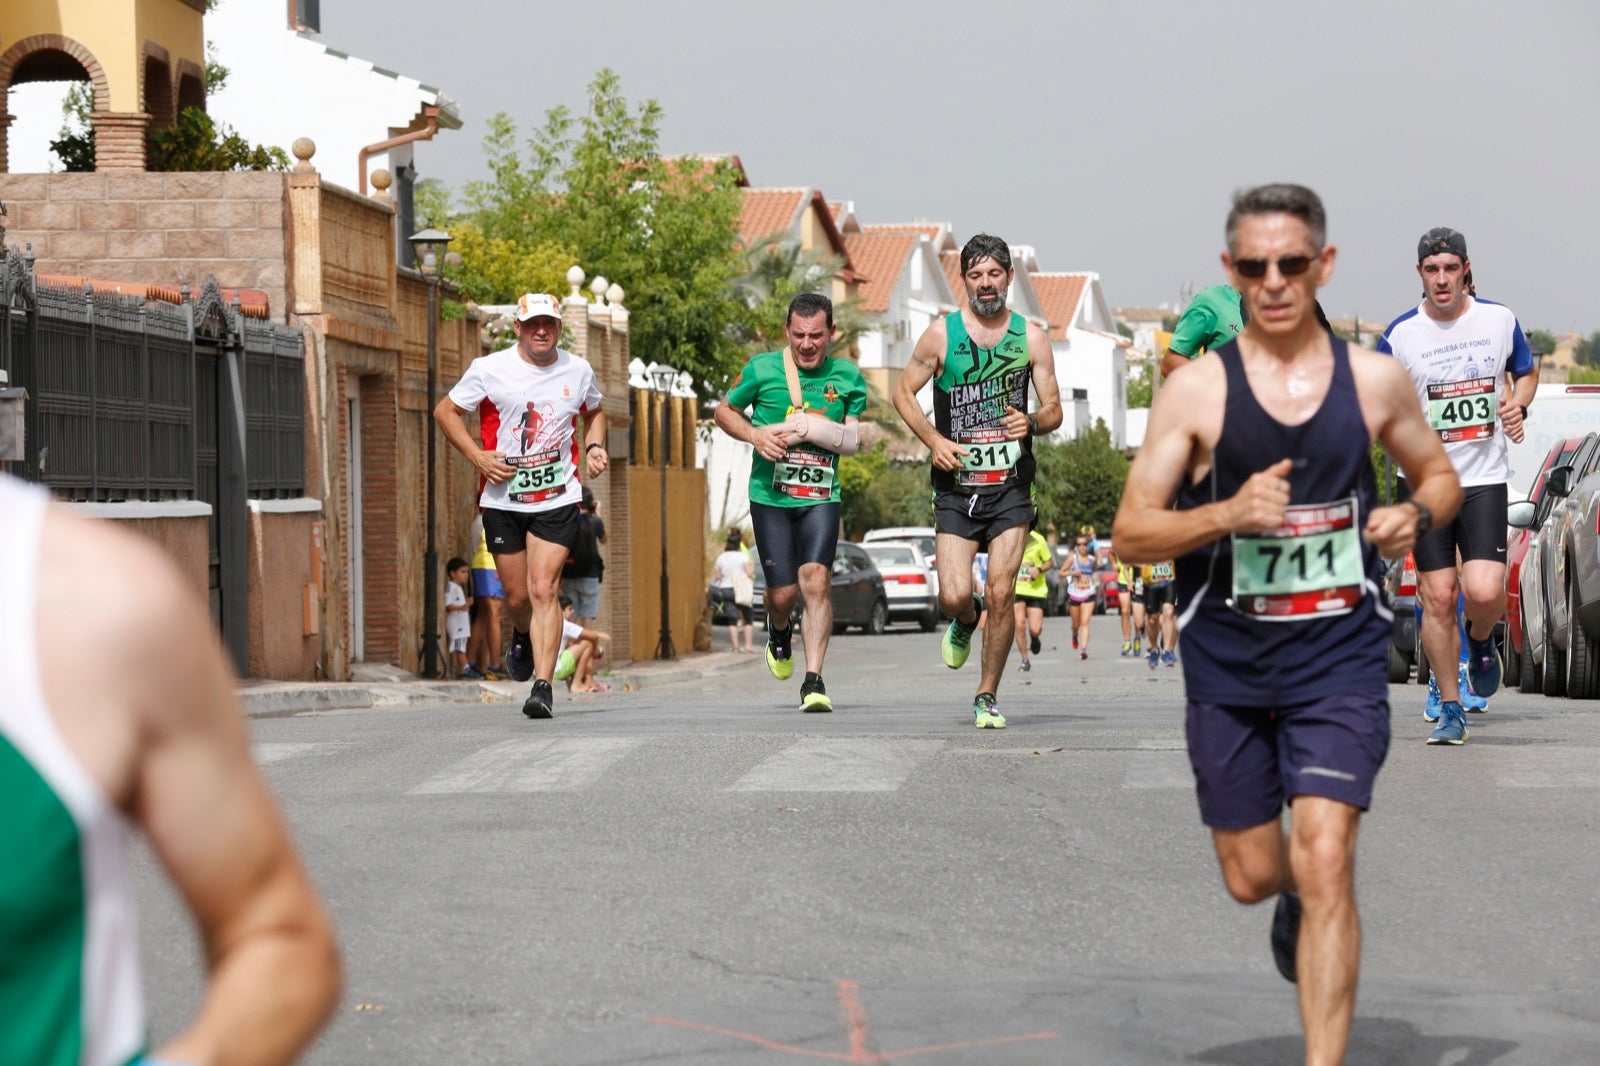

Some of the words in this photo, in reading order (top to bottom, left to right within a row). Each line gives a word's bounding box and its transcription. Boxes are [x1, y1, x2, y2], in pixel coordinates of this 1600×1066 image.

[1433, 344, 1459, 355] PRUEBA
[1459, 342, 1468, 350] DE
[1469, 338, 1491, 347] FONDO
[950, 384, 980, 407] TEAM
[967, 402, 979, 414] DE
[979, 394, 1008, 411] MENTE
[964, 413, 976, 428] DE
[1441, 397, 1490, 423] 403
[969, 445, 1011, 467] 311
[518, 466, 555, 488] 355
[785, 467, 824, 483] 763
[1258, 540, 1335, 584] 711
